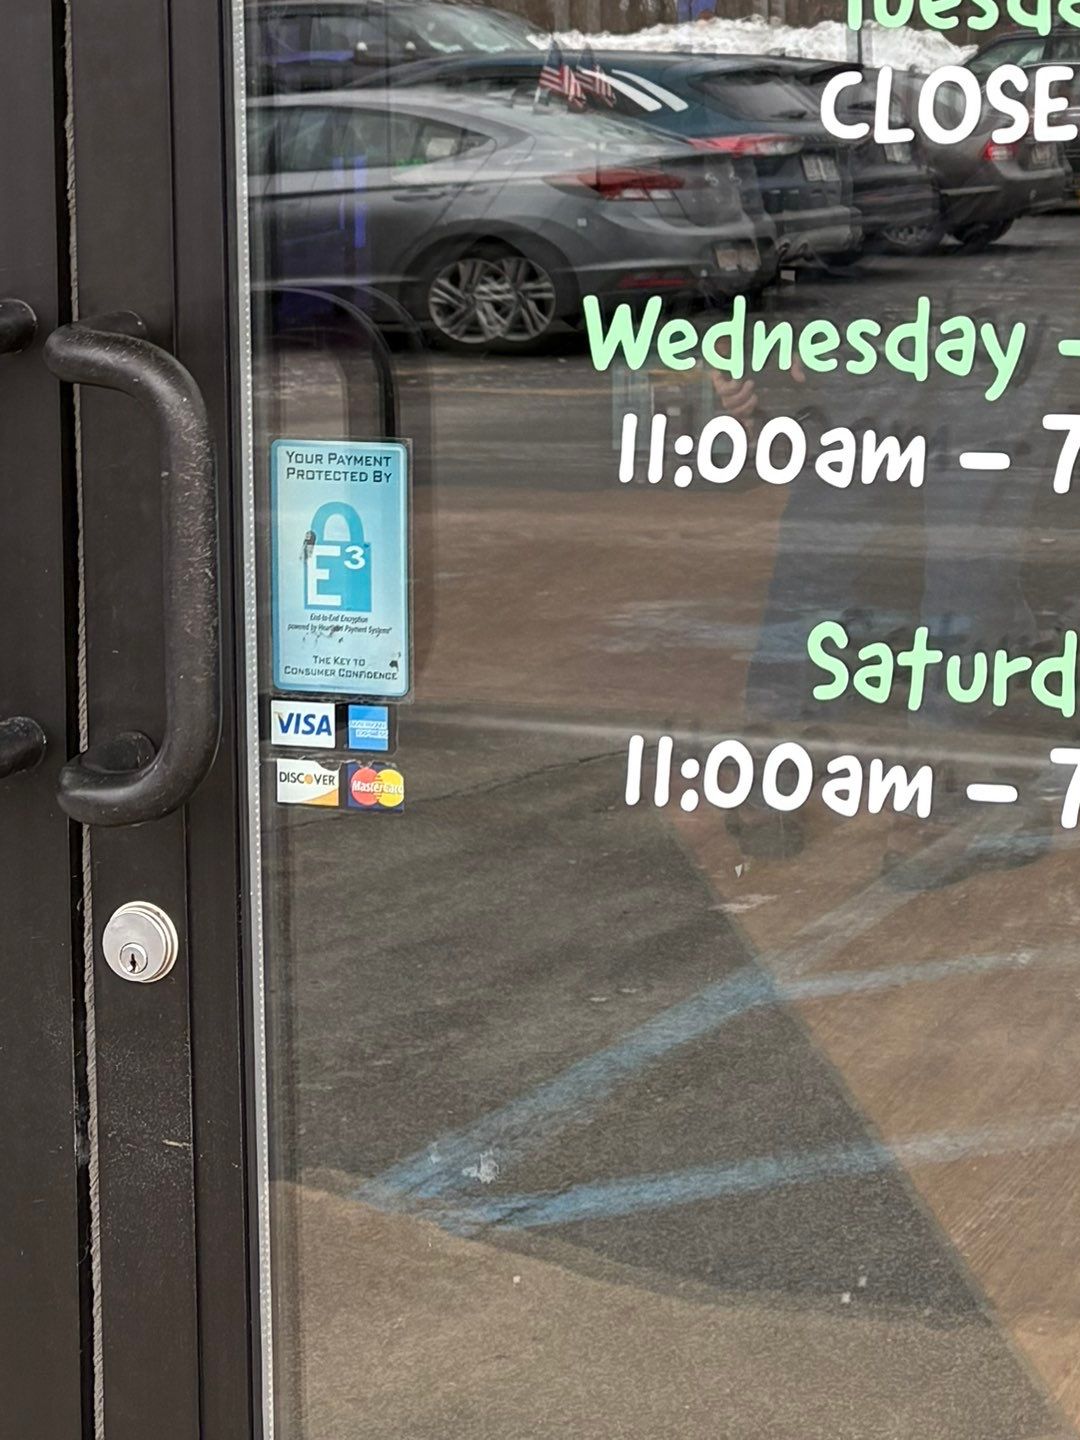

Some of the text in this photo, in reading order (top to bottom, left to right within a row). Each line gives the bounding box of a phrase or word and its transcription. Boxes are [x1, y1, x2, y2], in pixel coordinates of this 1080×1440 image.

[582, 295, 1027, 402] Wednesday
[286, 450, 393, 467] YOUR PAYMENT
[617, 412, 928, 489] 11:00am
[286, 467, 393, 483] PROTECTED BY
[313, 655, 366, 667] THE KEY TO
[284, 665, 398, 680] CONSUMER CONFIDENCE
[277, 712, 332, 736] VISA
[279, 771, 336, 786] DISCOVER
[624, 734, 935, 820] 11:00am
